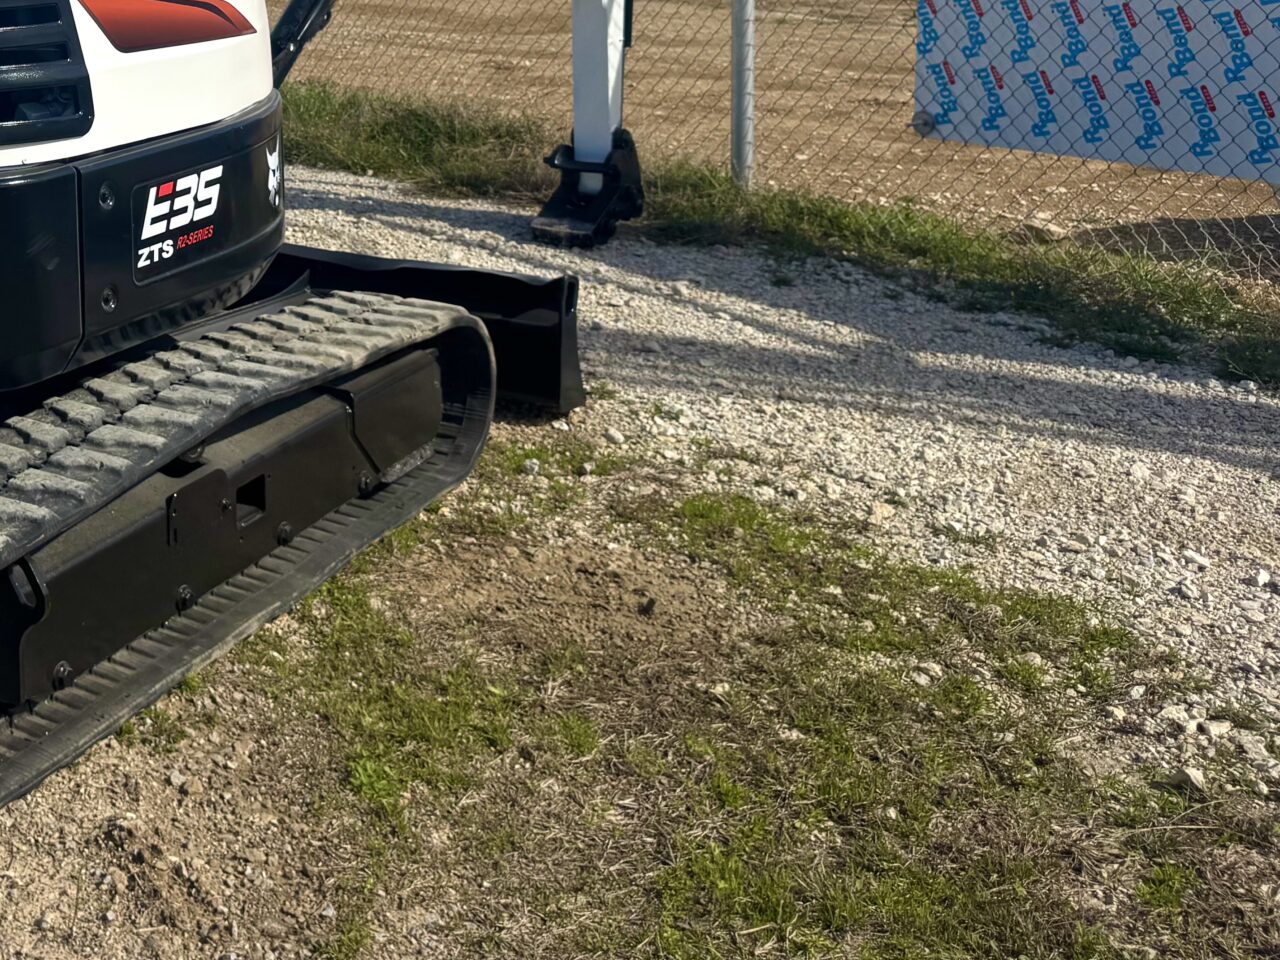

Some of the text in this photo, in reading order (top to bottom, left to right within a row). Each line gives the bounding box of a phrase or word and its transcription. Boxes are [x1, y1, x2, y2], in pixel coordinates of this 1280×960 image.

[141, 165, 224, 241] E35
[137, 224, 215, 269] ZTS R2-SERIES
